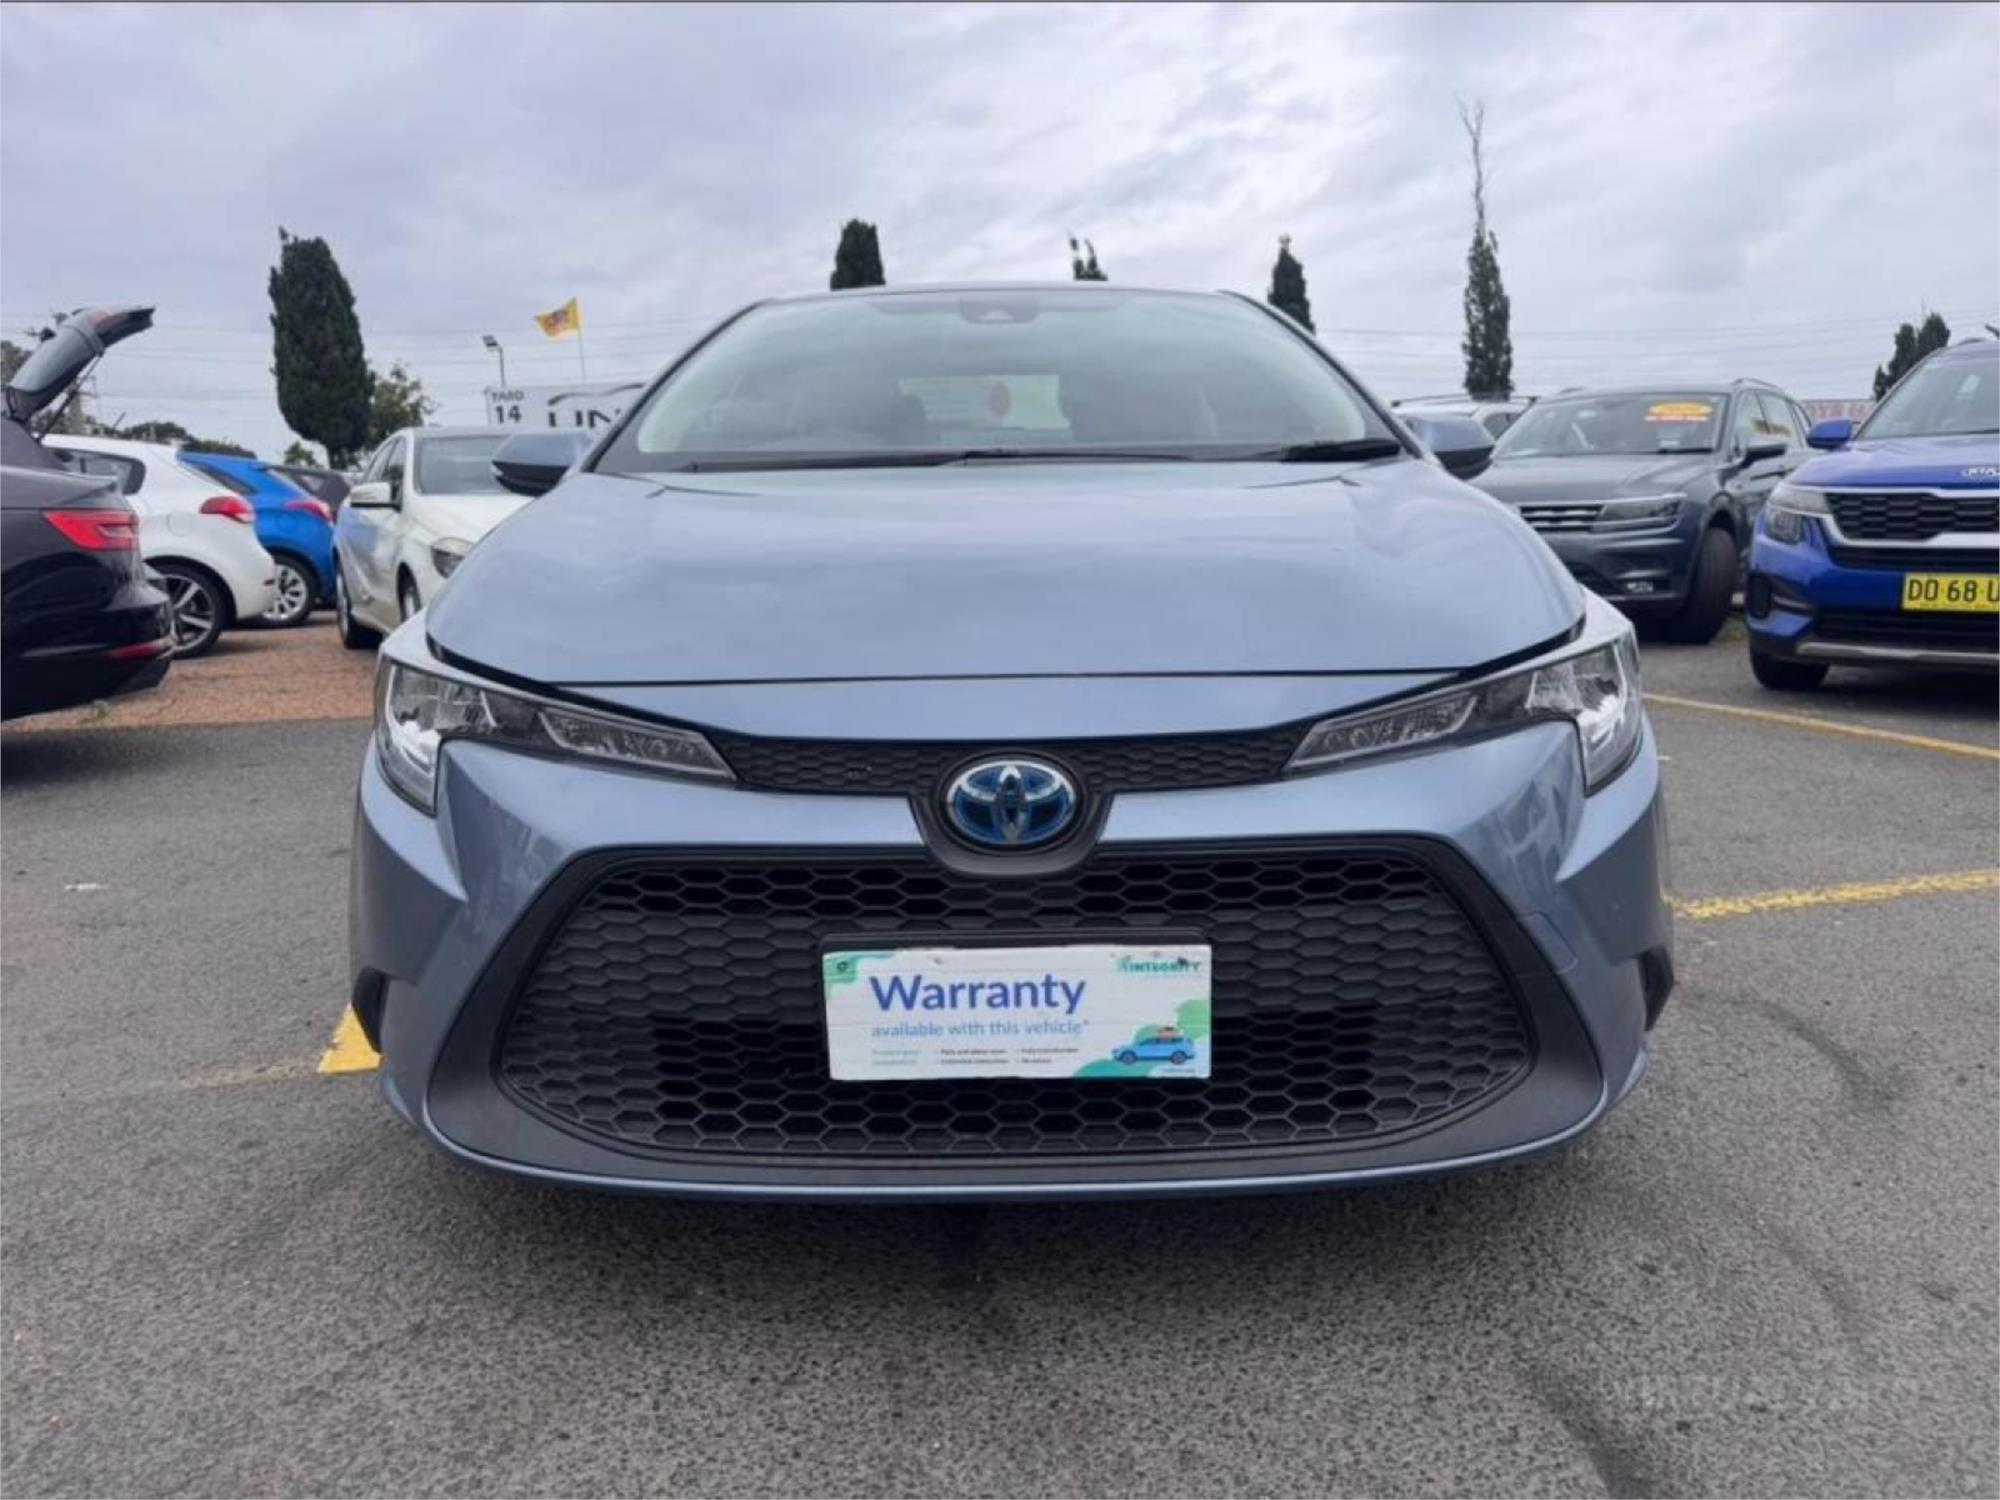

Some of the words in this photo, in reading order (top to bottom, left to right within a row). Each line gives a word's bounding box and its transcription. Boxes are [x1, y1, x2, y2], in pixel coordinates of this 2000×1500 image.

[492, 391, 525, 402] YARD
[496, 405, 522, 425] 14
[1947, 580, 1978, 602] 68
[868, 973, 1087, 1015] Warranty
[871, 1019, 943, 1039] available
[948, 1018, 988, 1037] with
[989, 1017, 1020, 1036] this
